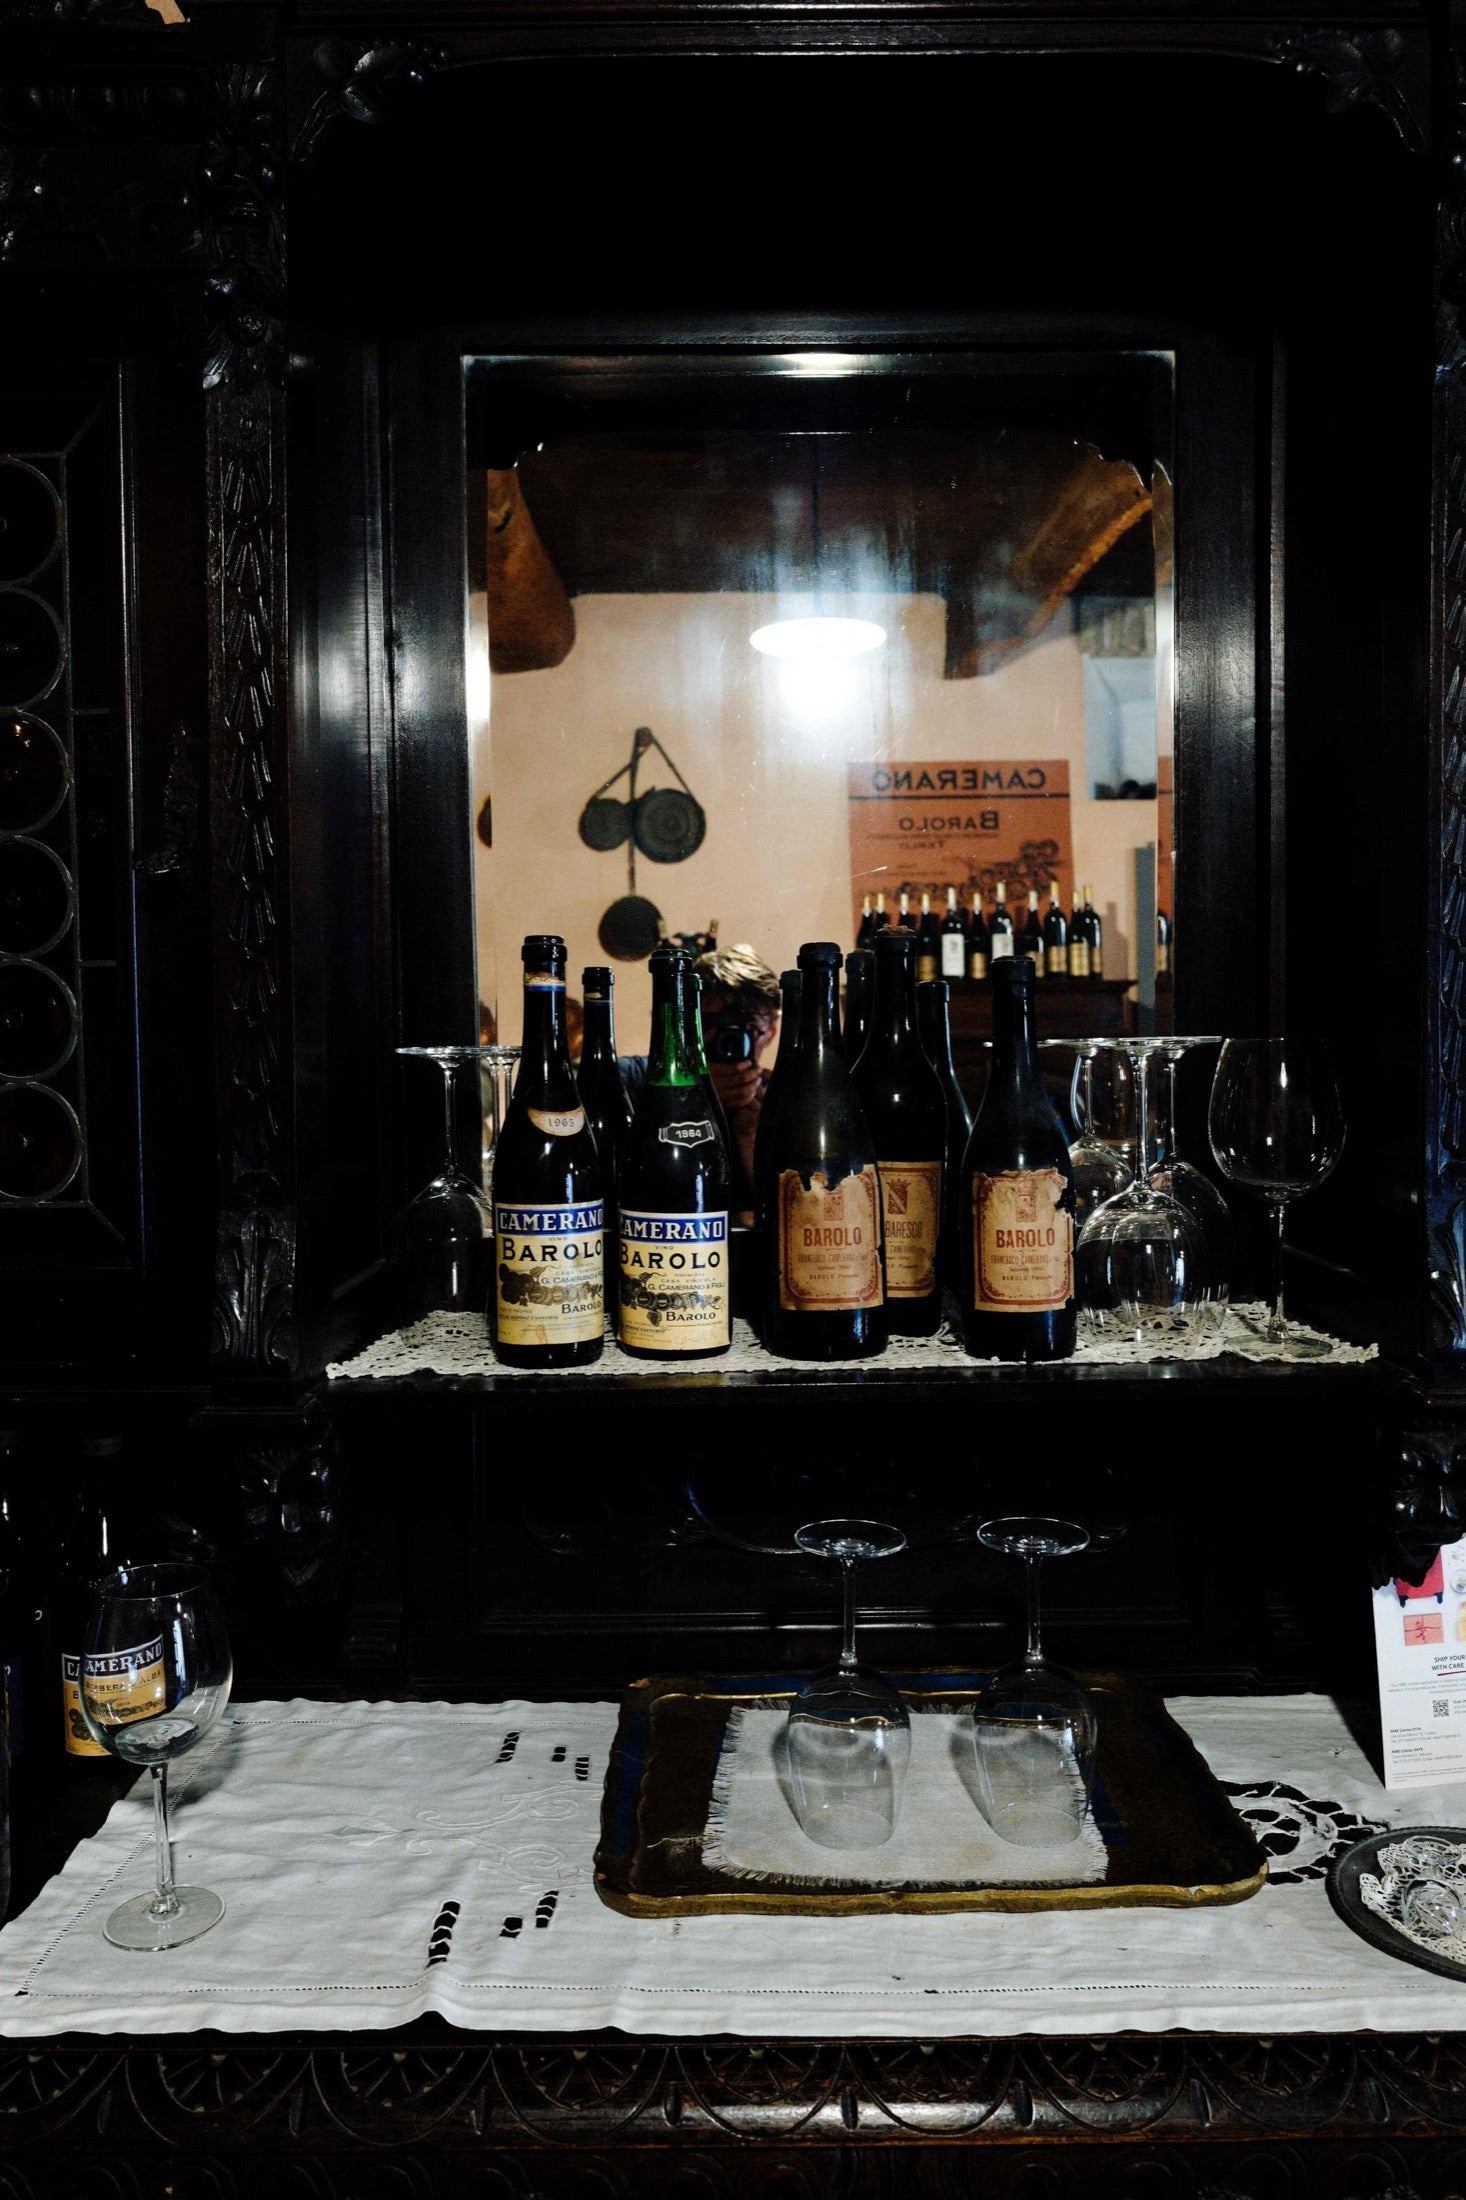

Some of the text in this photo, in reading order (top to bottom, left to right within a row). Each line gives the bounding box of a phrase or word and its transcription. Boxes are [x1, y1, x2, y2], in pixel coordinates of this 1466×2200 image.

[499, 1209, 603, 1231] CAMERANO
[620, 1218, 723, 1240] AMERANO
[803, 1227, 862, 1247] BAROLO
[996, 1228, 1055, 1248] BAROLO
[502, 1237, 602, 1261] BAROLO
[620, 1242, 721, 1269] BAROLO
[561, 1301, 602, 1315] BAROLO
[666, 1312, 716, 1322] BAROLO
[1448, 1662, 1465, 1670] CARE
